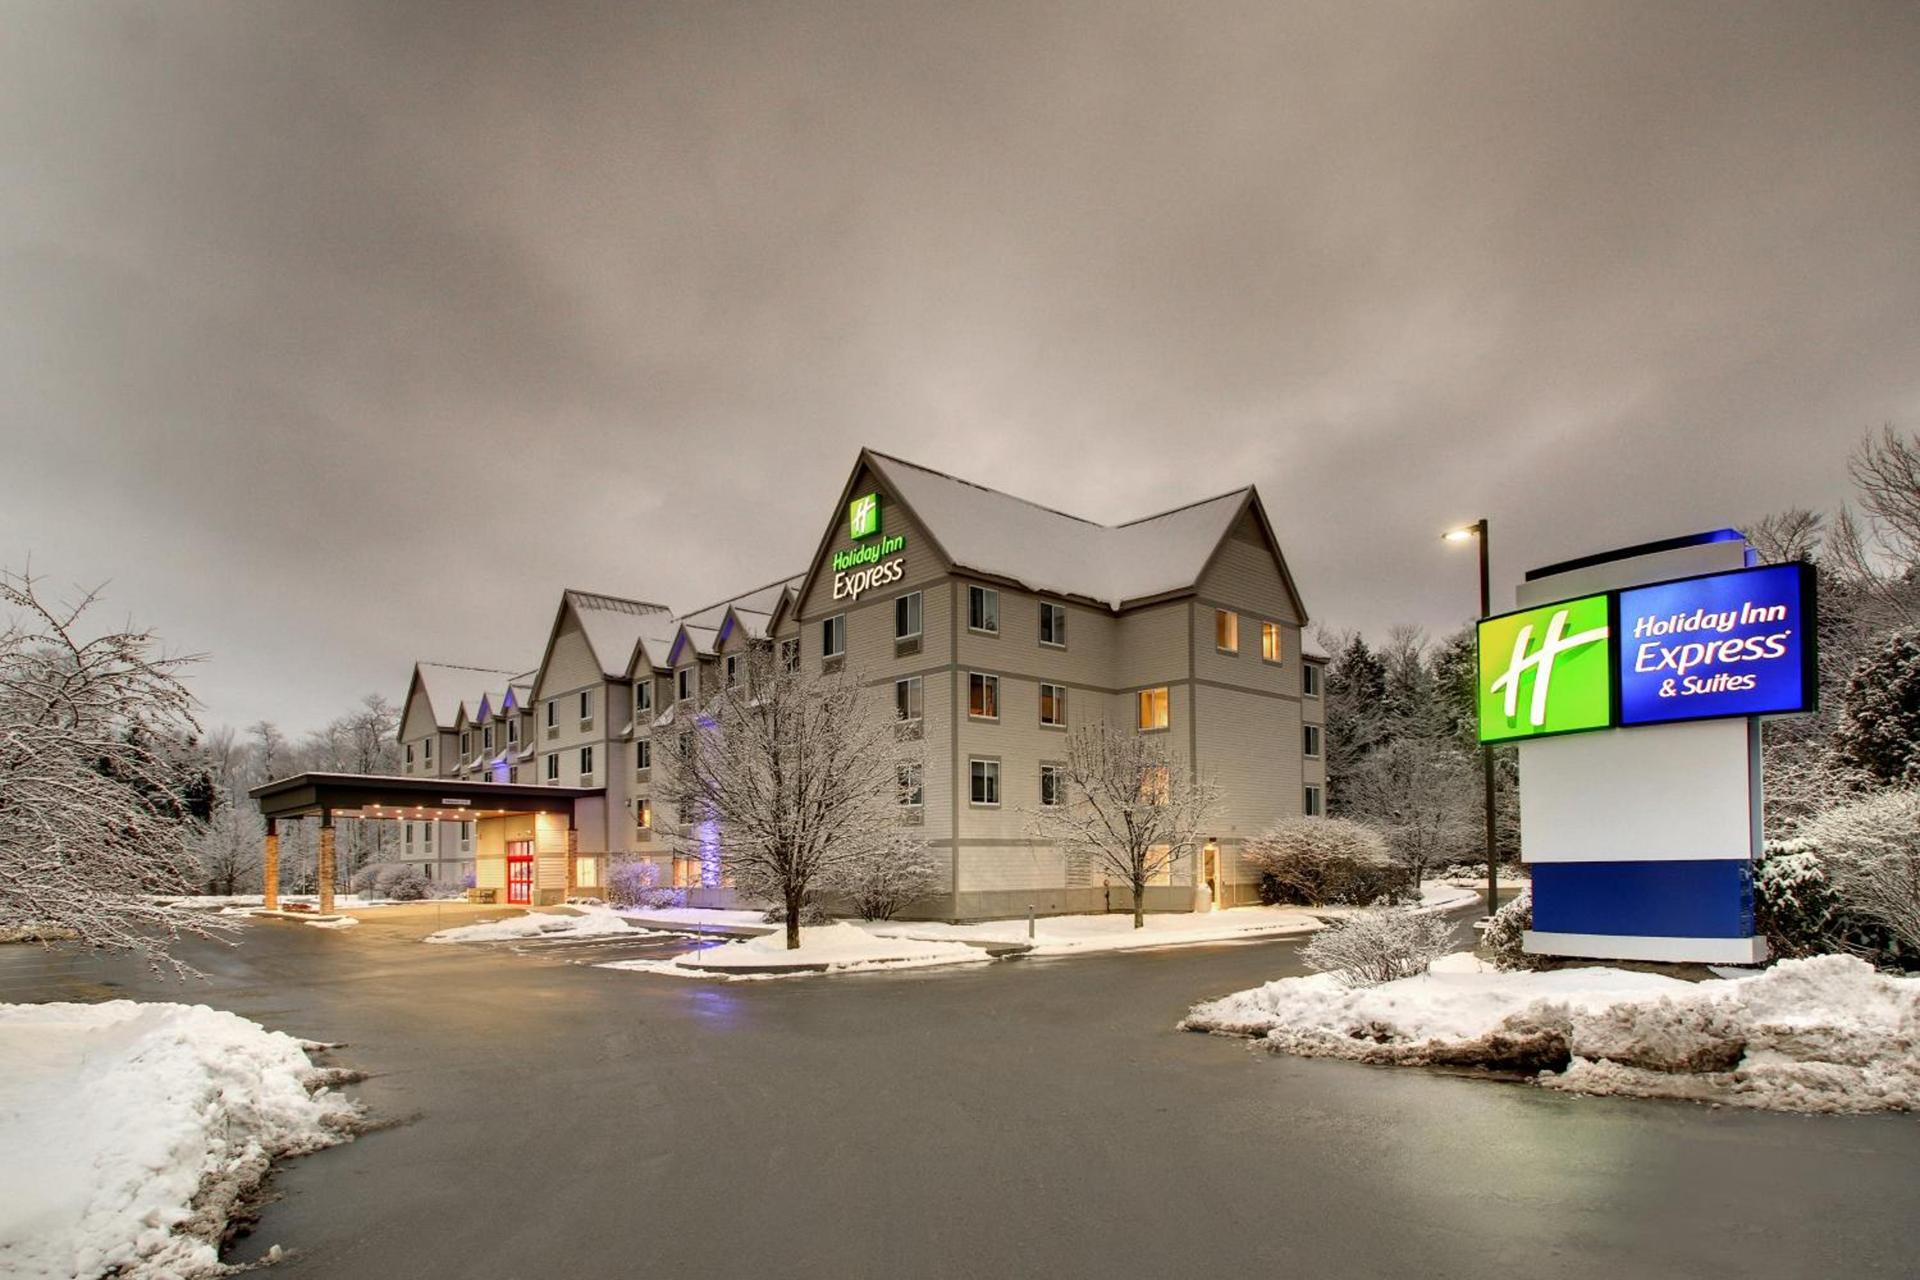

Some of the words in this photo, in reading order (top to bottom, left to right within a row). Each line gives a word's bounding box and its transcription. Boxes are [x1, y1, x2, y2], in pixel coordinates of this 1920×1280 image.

[833, 544, 880, 572] Holiday
[882, 536, 903, 555] Inn
[833, 558, 904, 601] Express
[1633, 610, 1737, 639] Holiday
[1740, 602, 1787, 626] Inn
[1634, 634, 1787, 676] Express
[1658, 679, 1677, 698] &
[1681, 673, 1756, 696] Suites
